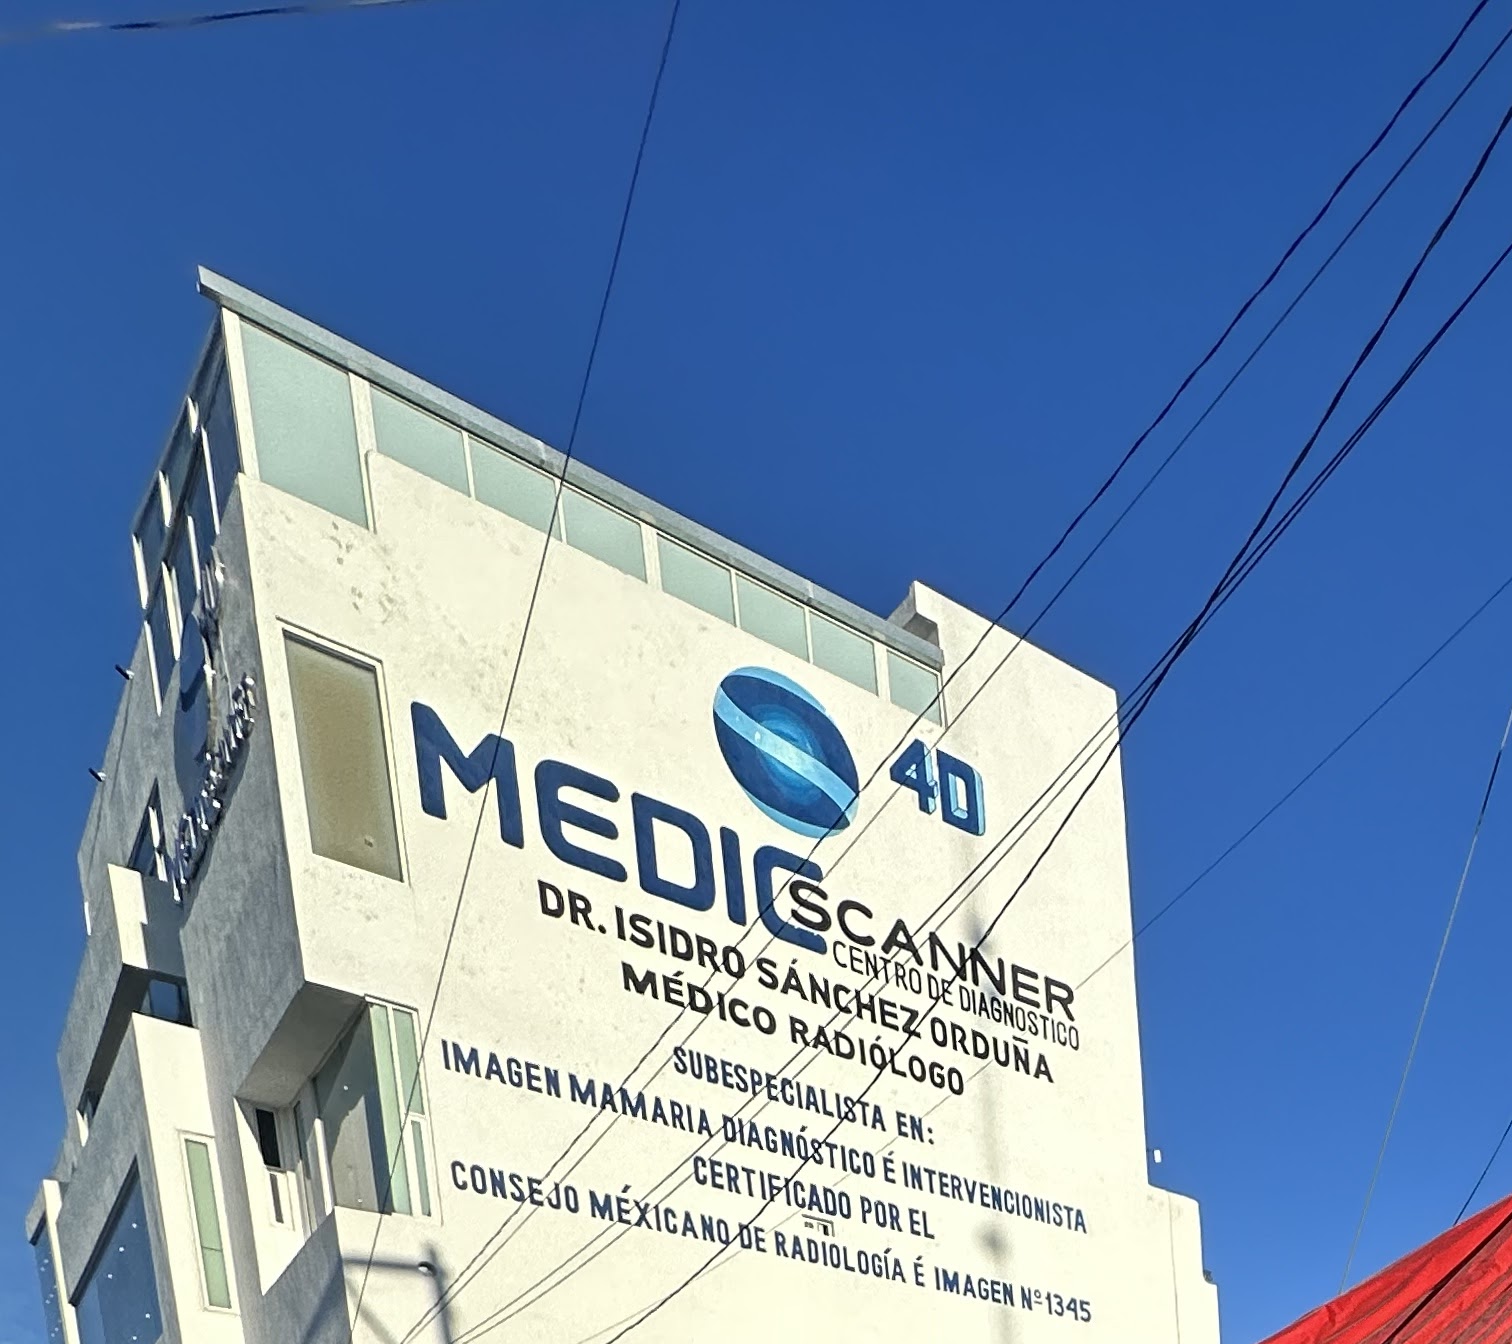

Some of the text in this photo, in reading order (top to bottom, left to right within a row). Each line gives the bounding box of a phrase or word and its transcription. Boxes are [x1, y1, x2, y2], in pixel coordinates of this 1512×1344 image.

[410, 700, 828, 955] MEDIC
[889, 738, 986, 836] 4D
[537, 879, 1055, 1084] DR. ISIDRO SÁNCHEZ ORDUÑA
[788, 879, 1076, 1022] SCANNER
[832, 940, 1080, 1052] CENTRO DE DIAGNOSTICO
[621, 960, 965, 1097] MÉDICO RADIÓLOGO
[672, 1046, 935, 1145] SUBESPECIALISTA EN:
[440, 1038, 562, 1099] IMAGEN
[568, 1071, 714, 1138] MAMARIA
[721, 1113, 876, 1178] DIAGNÓSTICO
[901, 1161, 1088, 1234] INTERVENCIONISTA
[692, 1155, 935, 1240] CERTIFICADO POR EL
[450, 1160, 580, 1214] CONSEJO
[588, 1184, 730, 1246] MÉXICANO
[738, 1221, 767, 1253] DE
[773, 1230, 907, 1284] RADIOLOGÍA
[934, 1266, 1015, 1307] IMAGEN
